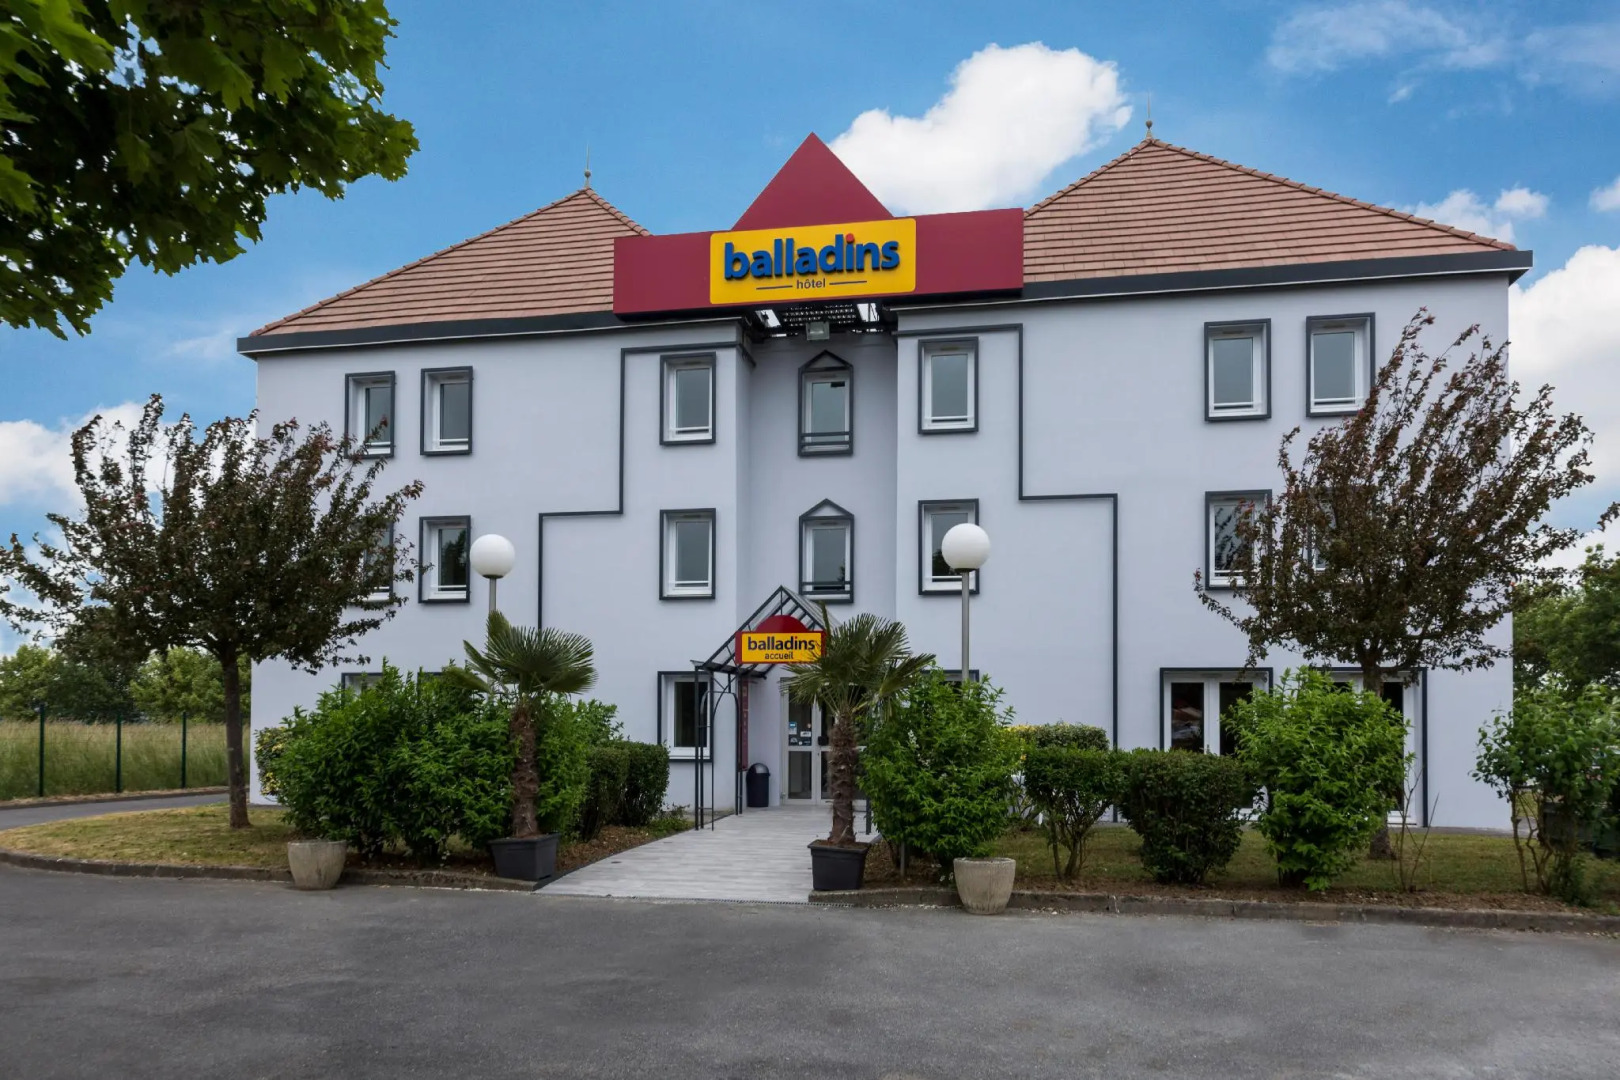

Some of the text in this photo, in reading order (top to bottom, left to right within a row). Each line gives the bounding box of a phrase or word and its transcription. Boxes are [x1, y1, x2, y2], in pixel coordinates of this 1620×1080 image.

[724, 233, 900, 280] balladins
[796, 278, 826, 290] hôtel
[748, 636, 815, 651] balladins
[765, 652, 794, 660] accueil
